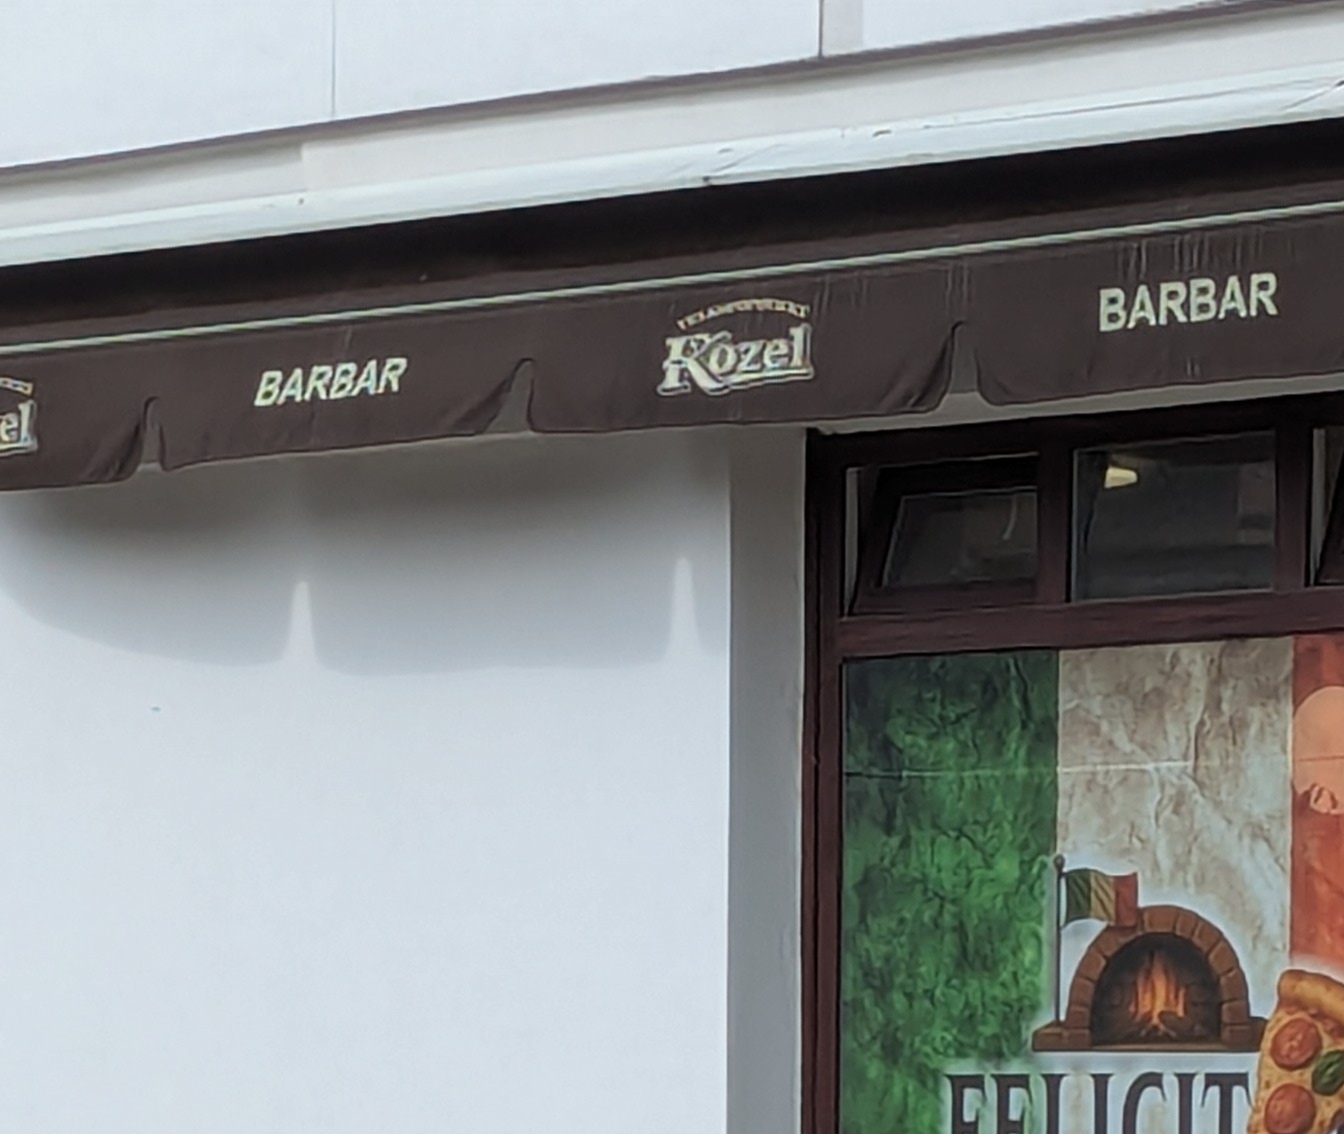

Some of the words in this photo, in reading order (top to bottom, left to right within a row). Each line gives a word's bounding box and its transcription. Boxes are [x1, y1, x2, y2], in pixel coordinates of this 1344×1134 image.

[1099, 272, 1278, 332] BARBAR
[254, 357, 408, 406] BARBAR
[657, 323, 814, 396] Kozel
